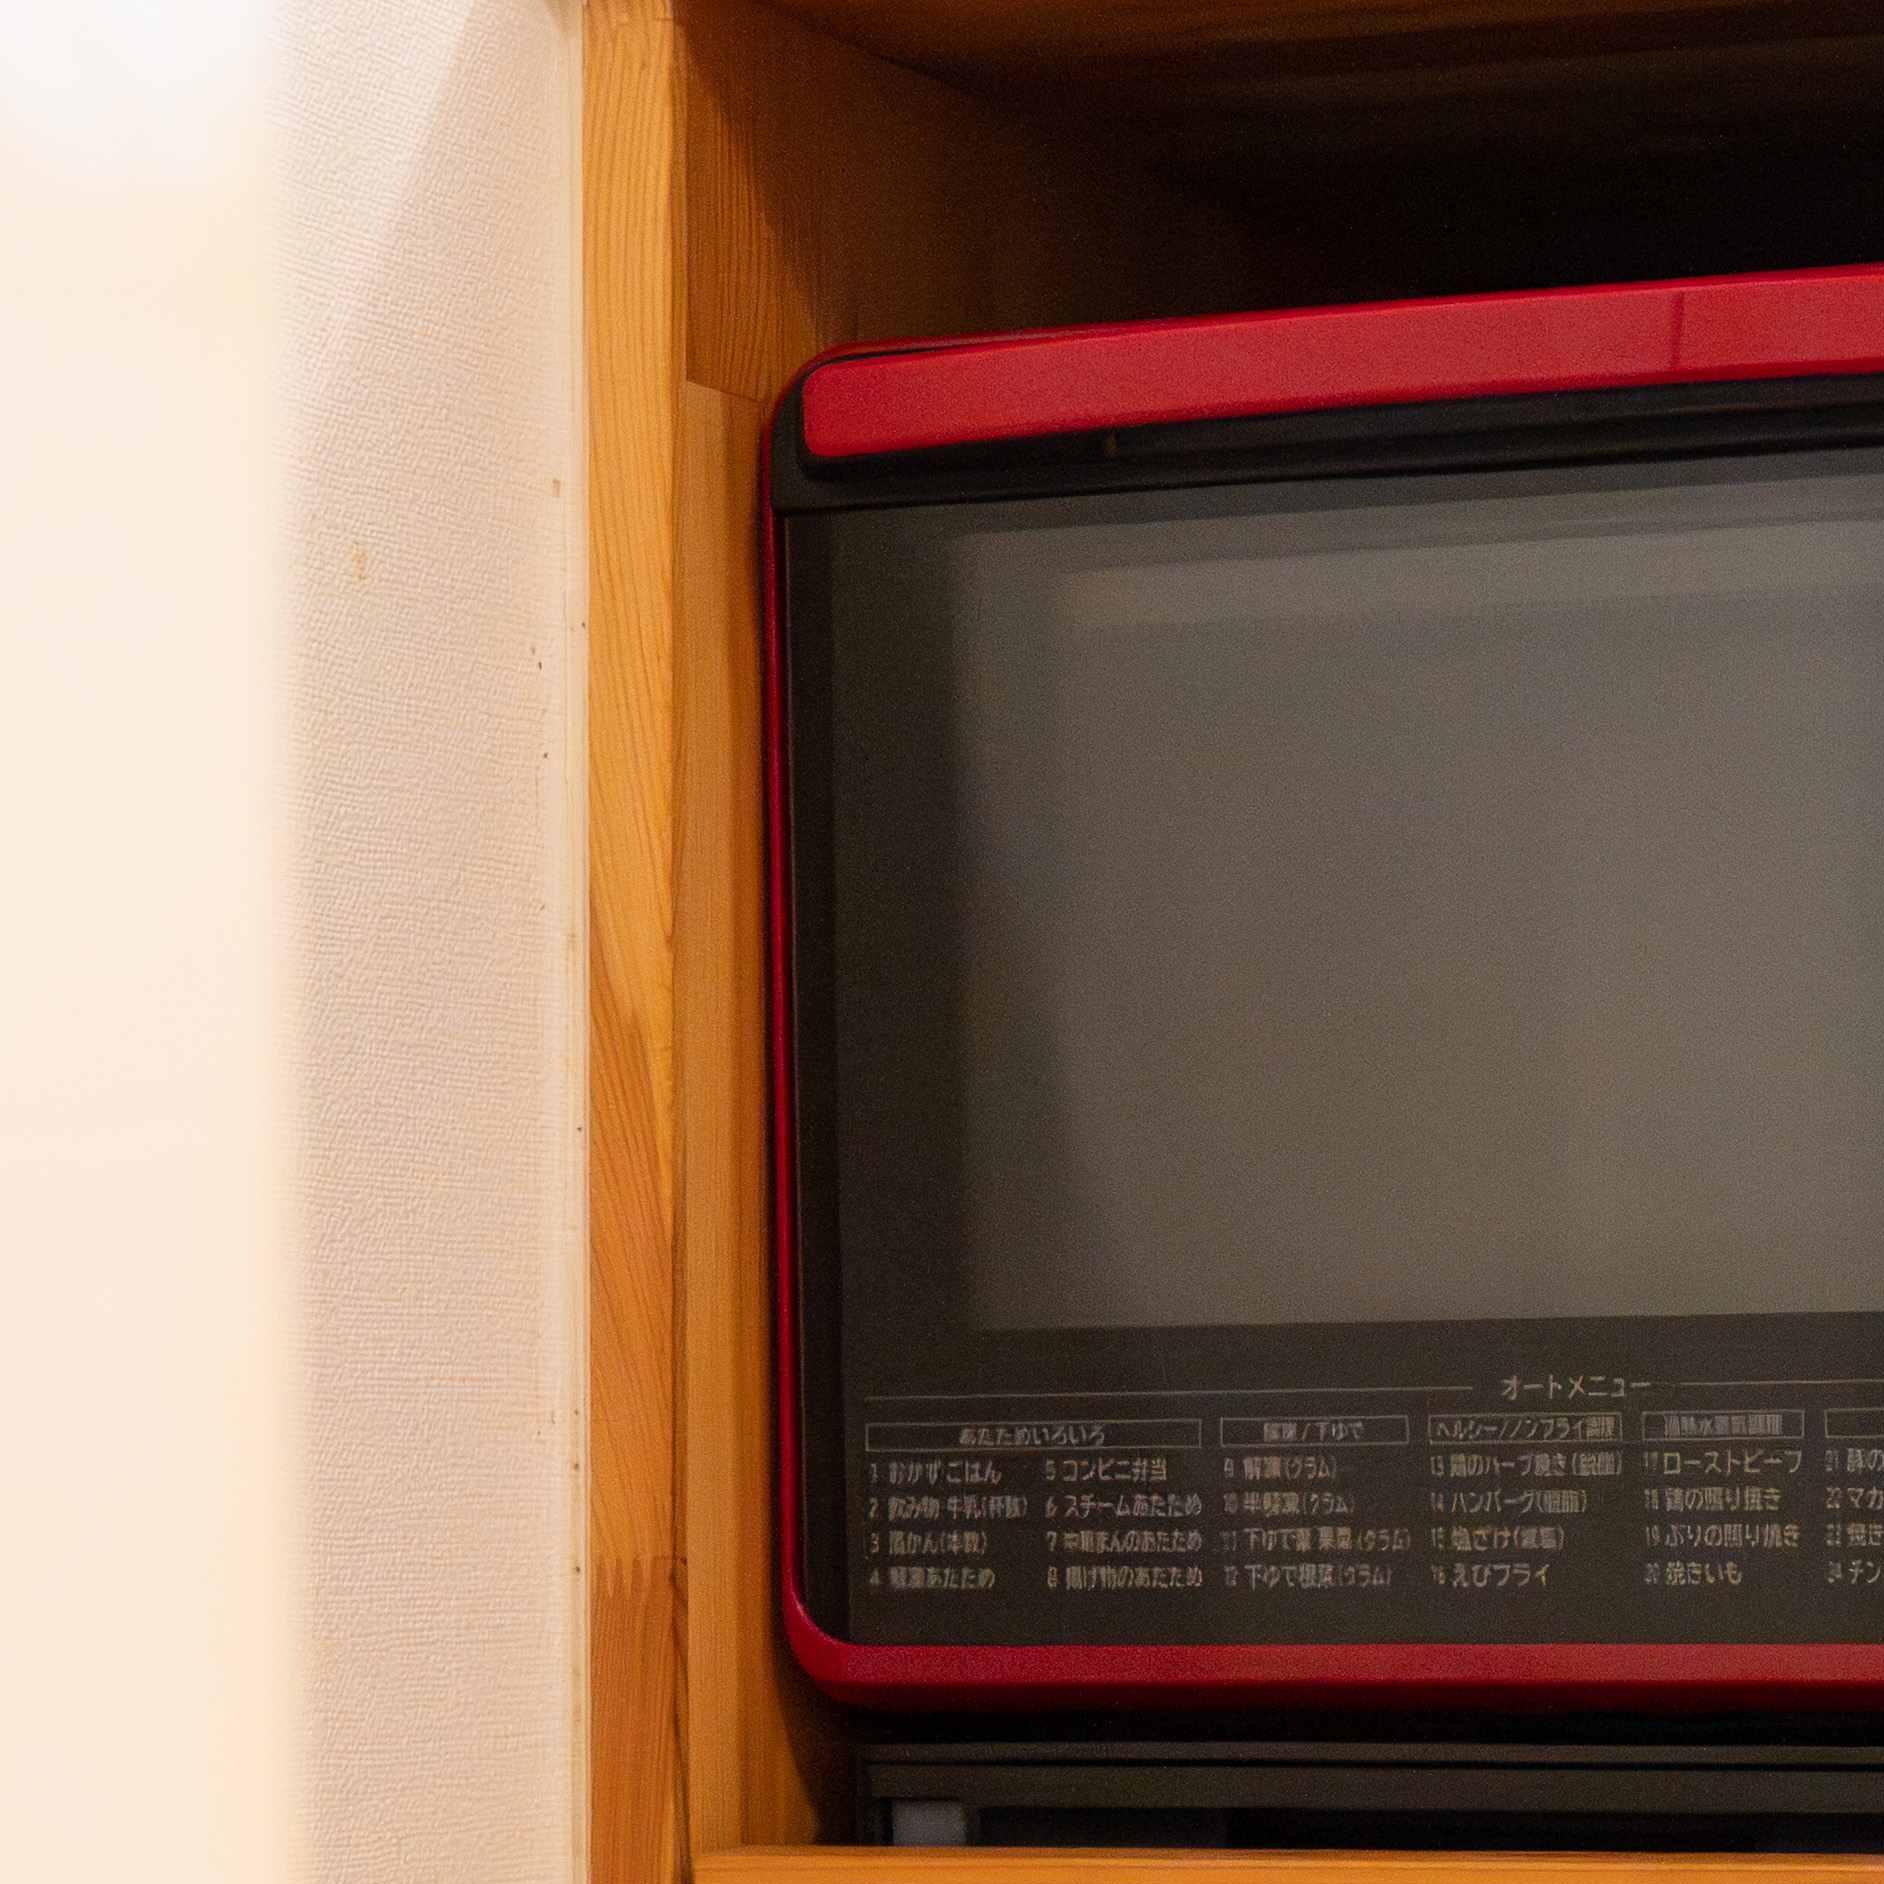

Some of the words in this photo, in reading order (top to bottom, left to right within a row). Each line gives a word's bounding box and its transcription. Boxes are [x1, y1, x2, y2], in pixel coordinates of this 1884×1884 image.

[1502, 1374, 1651, 1400] オートメニュー
